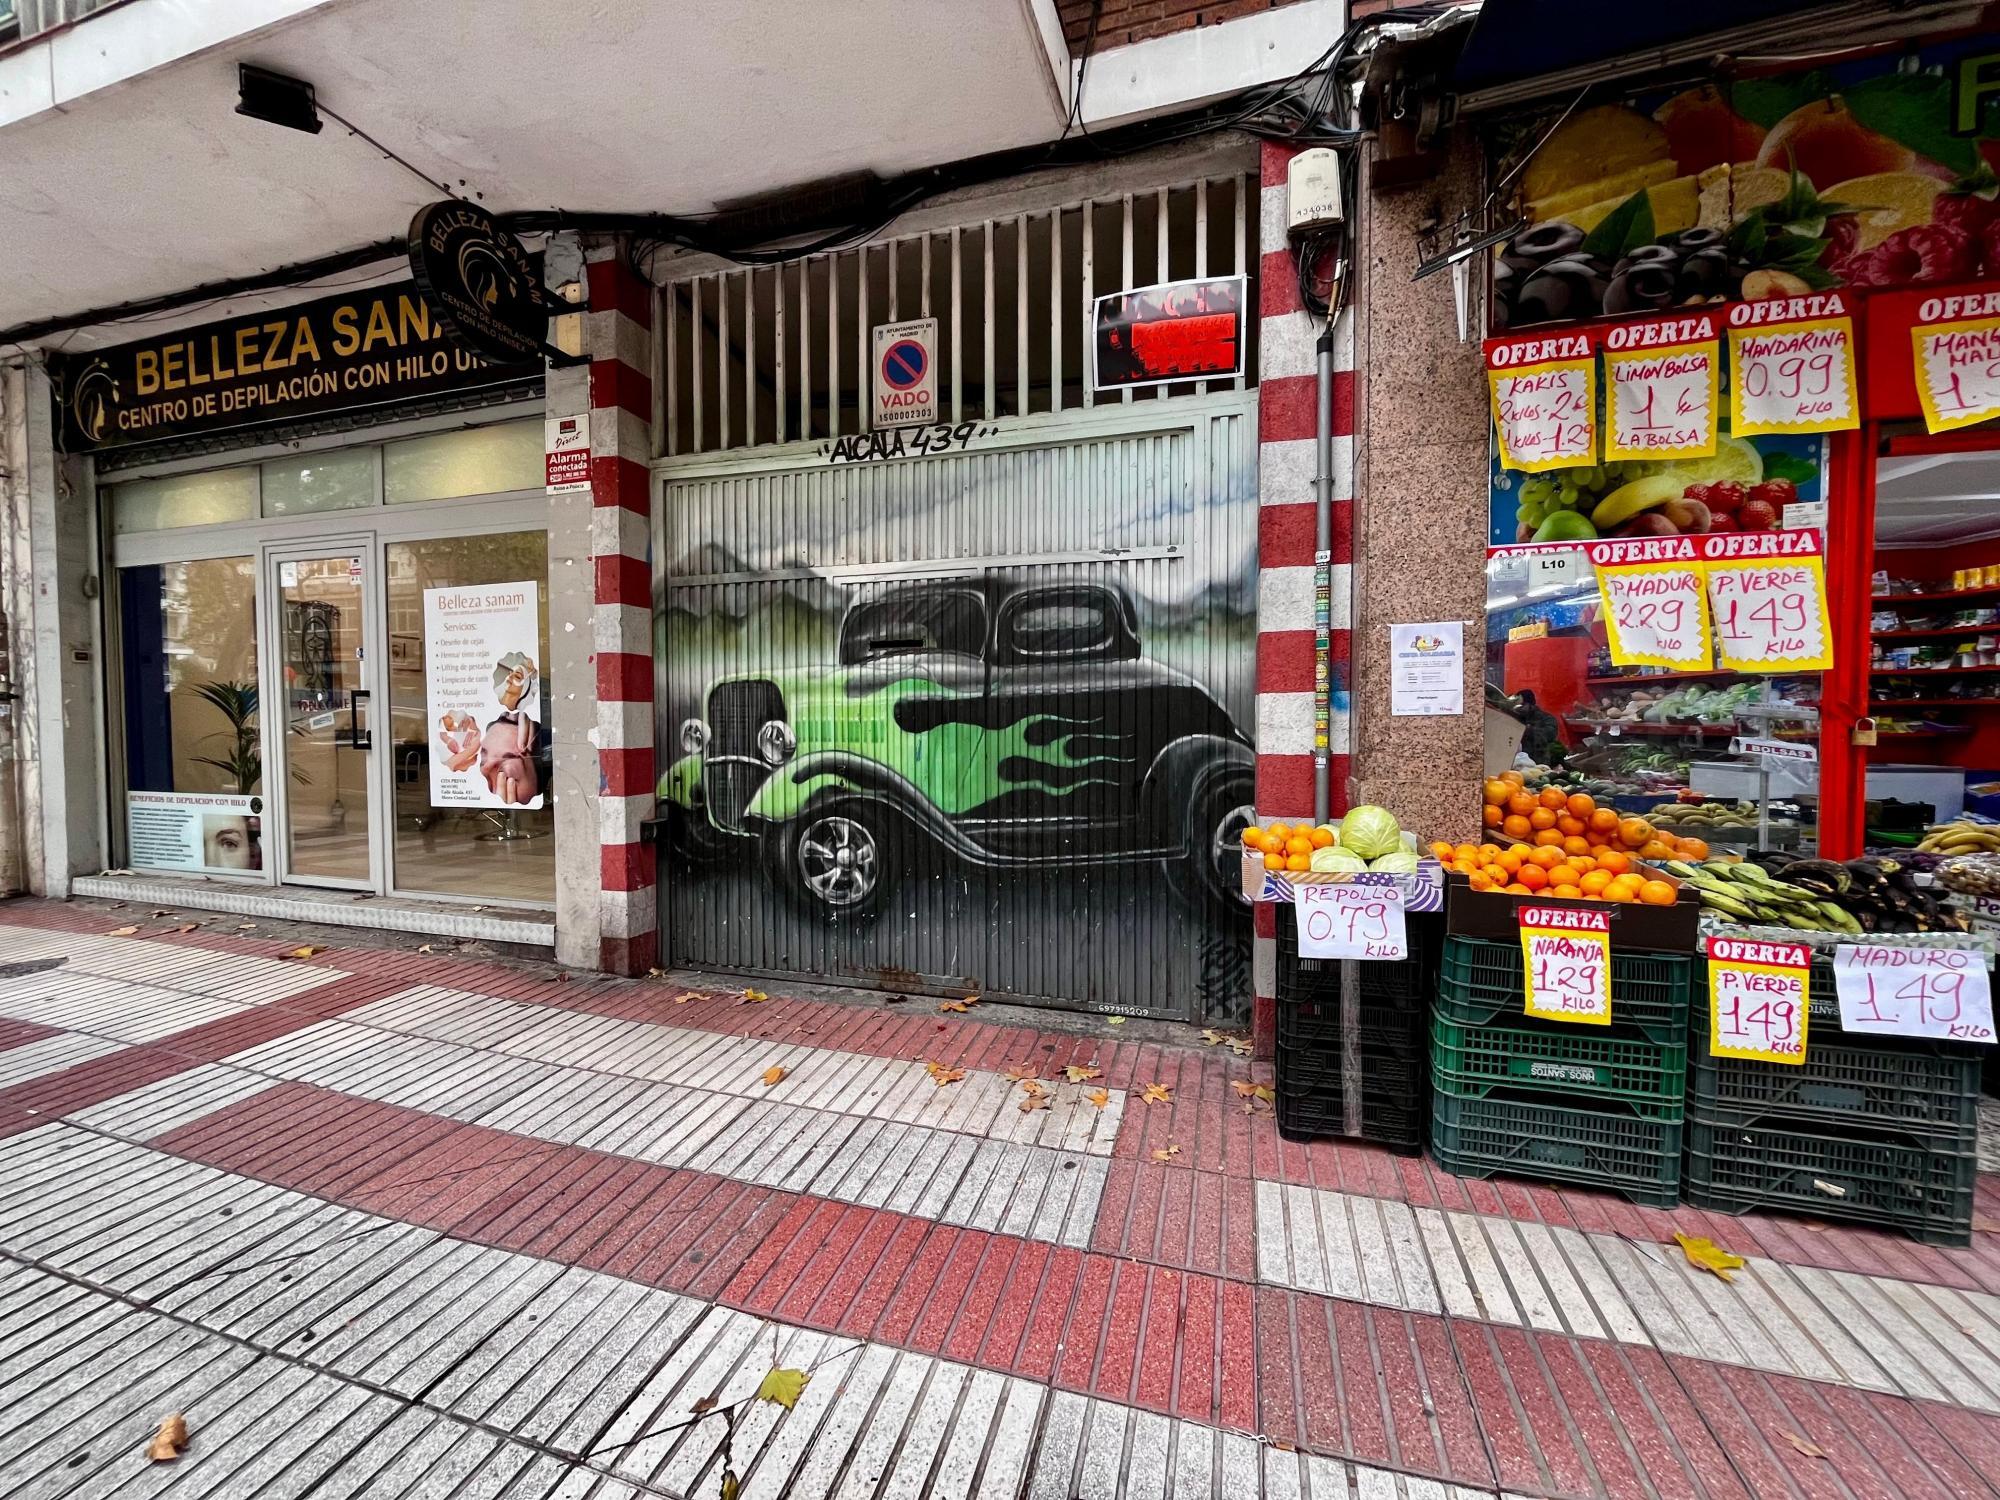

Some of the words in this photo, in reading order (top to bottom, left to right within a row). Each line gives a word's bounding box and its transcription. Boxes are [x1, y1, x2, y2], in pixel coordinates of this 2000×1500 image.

[430, 211, 493, 254] BELLEZA
[498, 233, 542, 304] SANAM
[1730, 293, 1846, 326] OFERTA
[887, 323, 925, 333] AYUNTAMIENTO
[1608, 316, 1713, 350] OFERTA
[136, 316, 321, 396] BELLEZA
[332, 294, 442, 359] SAN
[1491, 335, 1591, 367] OFERTA
[1740, 331, 1848, 359] MANDARINA
[1508, 373, 1568, 397] KAKIS
[1746, 354, 1833, 398] 0.99
[118, 398, 188, 431] CENTRO
[194, 393, 217, 418] DE
[222, 368, 338, 413] DEPILACIÓN
[348, 363, 390, 391] CON
[397, 350, 448, 382] HILO
[880, 389, 930, 409] VADO
[879, 408, 933, 422] 1500002303
[1796, 401, 1833, 416] KILO
[1618, 431, 1640, 446] LA
[1643, 429, 1699, 445] BOLSA
[549, 452, 588, 465] Alarma
[549, 461, 588, 473] conectada
[1592, 538, 1696, 565] OFERTA
[1704, 532, 1816, 558] OFERTA
[1541, 559, 1565, 570] L10
[1740, 571, 1808, 594] VERDE
[438, 593, 481, 610] Belleza
[485, 592, 525, 607] sanam
[1618, 599, 1684, 632] 2.29
[1719, 593, 1807, 639] 1.49
[1656, 635, 1682, 650] KILO
[1764, 637, 1805, 655] KILO
[1751, 744, 1807, 758] BOLSAS
[1303, 886, 1399, 904] REPOLLO
[1307, 903, 1388, 942] 0.79
[1524, 908, 1609, 930] OFERTA
[1364, 942, 1399, 957] KILO
[1534, 937, 1605, 963] NARANJA
[1713, 940, 1807, 966] OFERTA
[1848, 946, 1969, 971] MADURO
[1533, 958, 1598, 995] 1.29
[1742, 973, 1803, 996] VERDE
[1561, 992, 1596, 1010] KILO
[1855, 972, 1965, 1025] 1.49
[1098, 1004, 1149, 1017] 697915209
[1721, 995, 1794, 1042] 1.49
[1948, 1023, 1991, 1038] KILO
[1770, 1040, 1804, 1053] KILO
